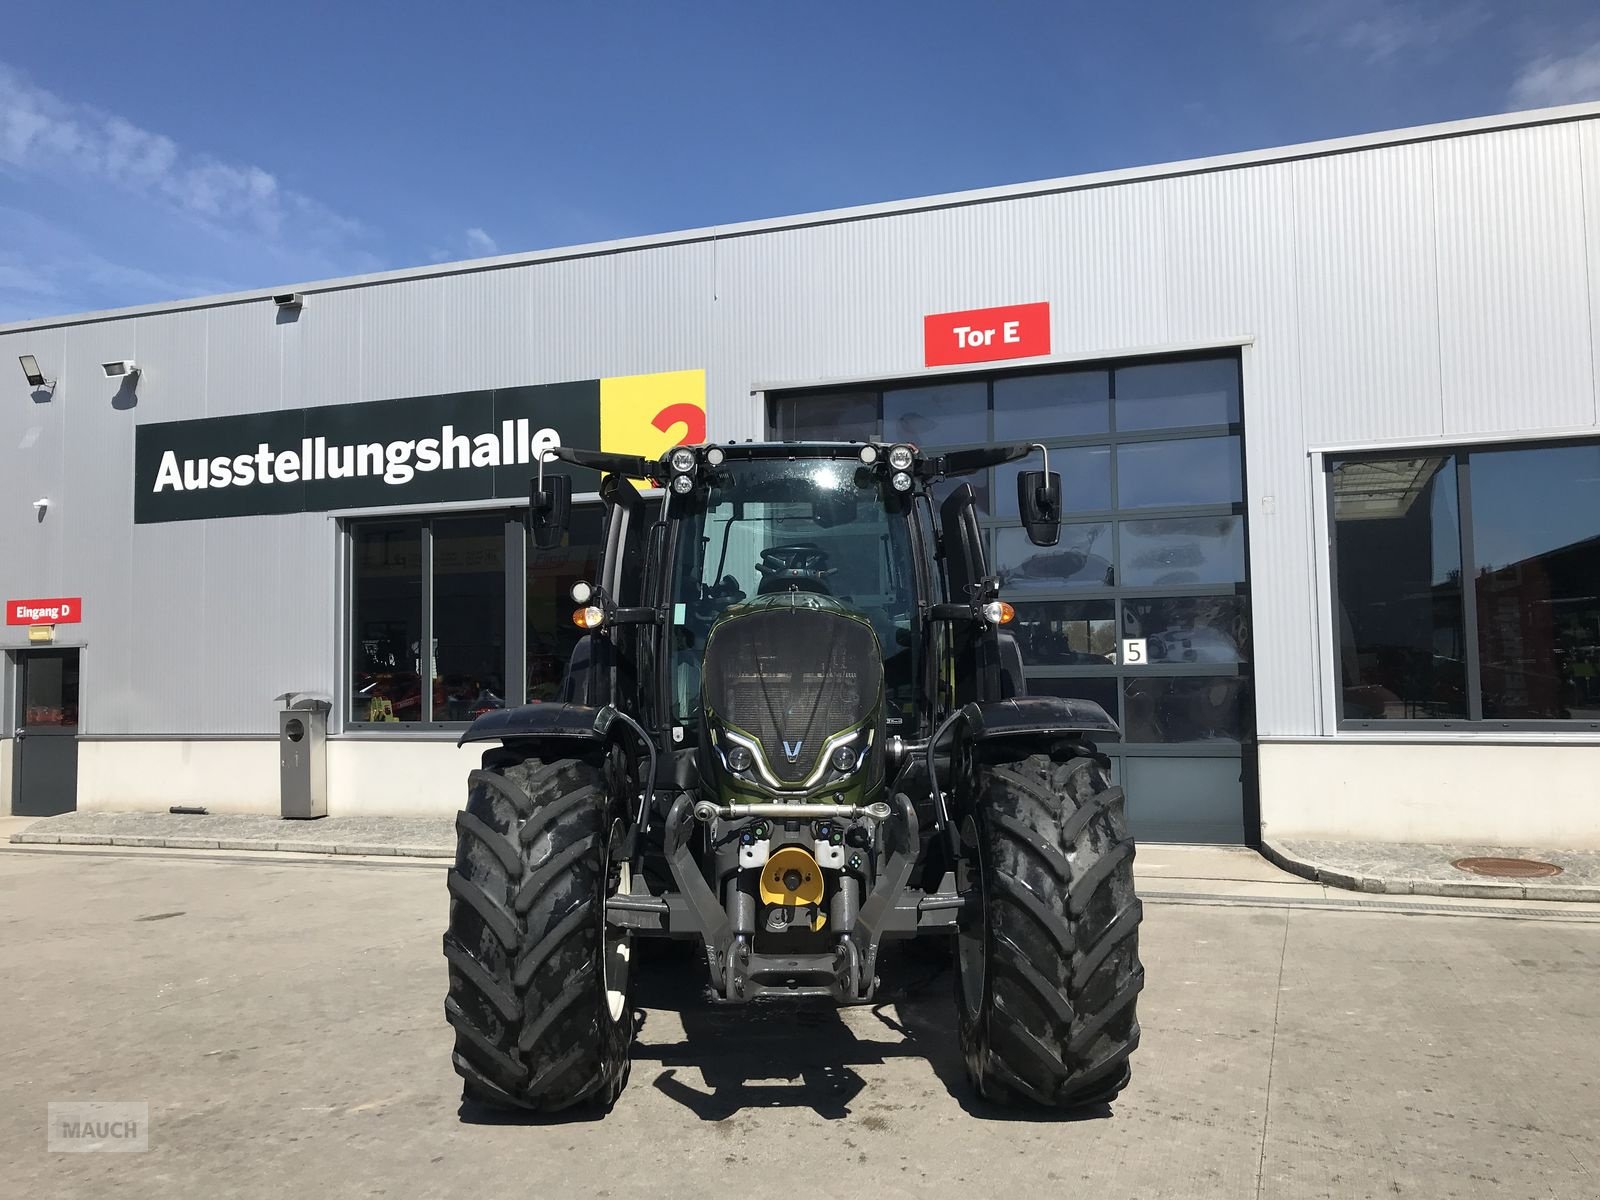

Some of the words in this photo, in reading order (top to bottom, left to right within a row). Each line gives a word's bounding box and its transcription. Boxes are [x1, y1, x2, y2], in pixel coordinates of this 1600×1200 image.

[953, 326, 996, 348] Tor
[1003, 321, 1020, 343] E
[153, 418, 560, 492] Ausstellungshalle
[16, 606, 59, 620] Eingang
[61, 604, 70, 616] D
[1128, 642, 1141, 662] 5
